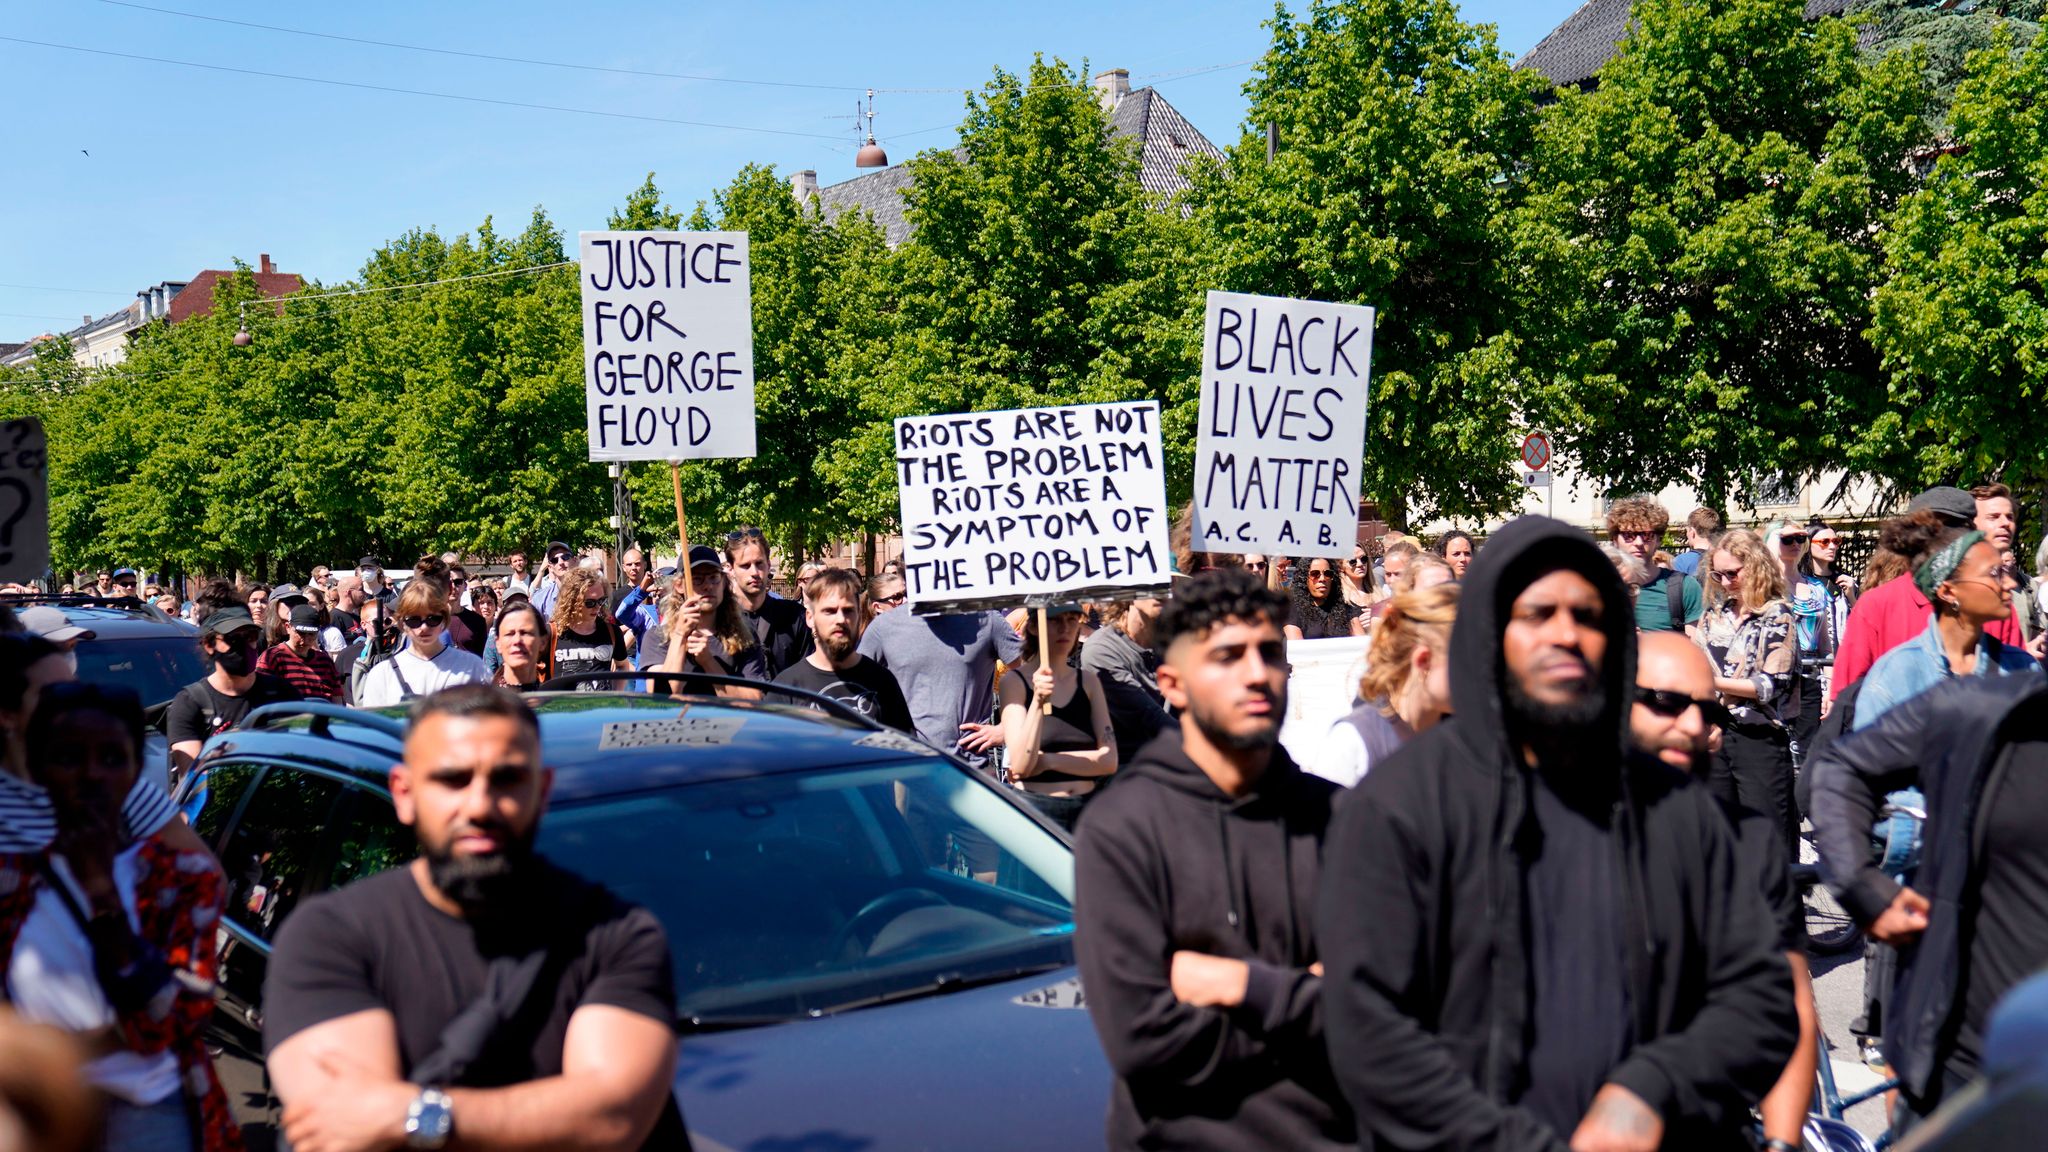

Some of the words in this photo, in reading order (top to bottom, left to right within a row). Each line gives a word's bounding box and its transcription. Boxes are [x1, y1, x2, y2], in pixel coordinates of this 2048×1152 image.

[591, 236, 742, 291] JUSTICE
[595, 300, 687, 345] FOR
[1215, 307, 1359, 377] BLACK
[594, 350, 742, 397] GEORGE
[599, 404, 711, 448] FLOYD
[1014, 410, 1082, 440] ARE
[1095, 406, 1155, 435] NOT
[1211, 381, 1343, 442] LIVES
[898, 452, 967, 486] THE
[985, 441, 1154, 480] PROBLEM
[1204, 450, 1356, 516] MATTER
[1036, 478, 1091, 506] ARE
[1102, 476, 1122, 501] A
[911, 509, 1100, 550] SYMPTOM
[1112, 506, 1154, 534] OF
[906, 558, 973, 594] THE
[984, 540, 1158, 586] PROBLEM
